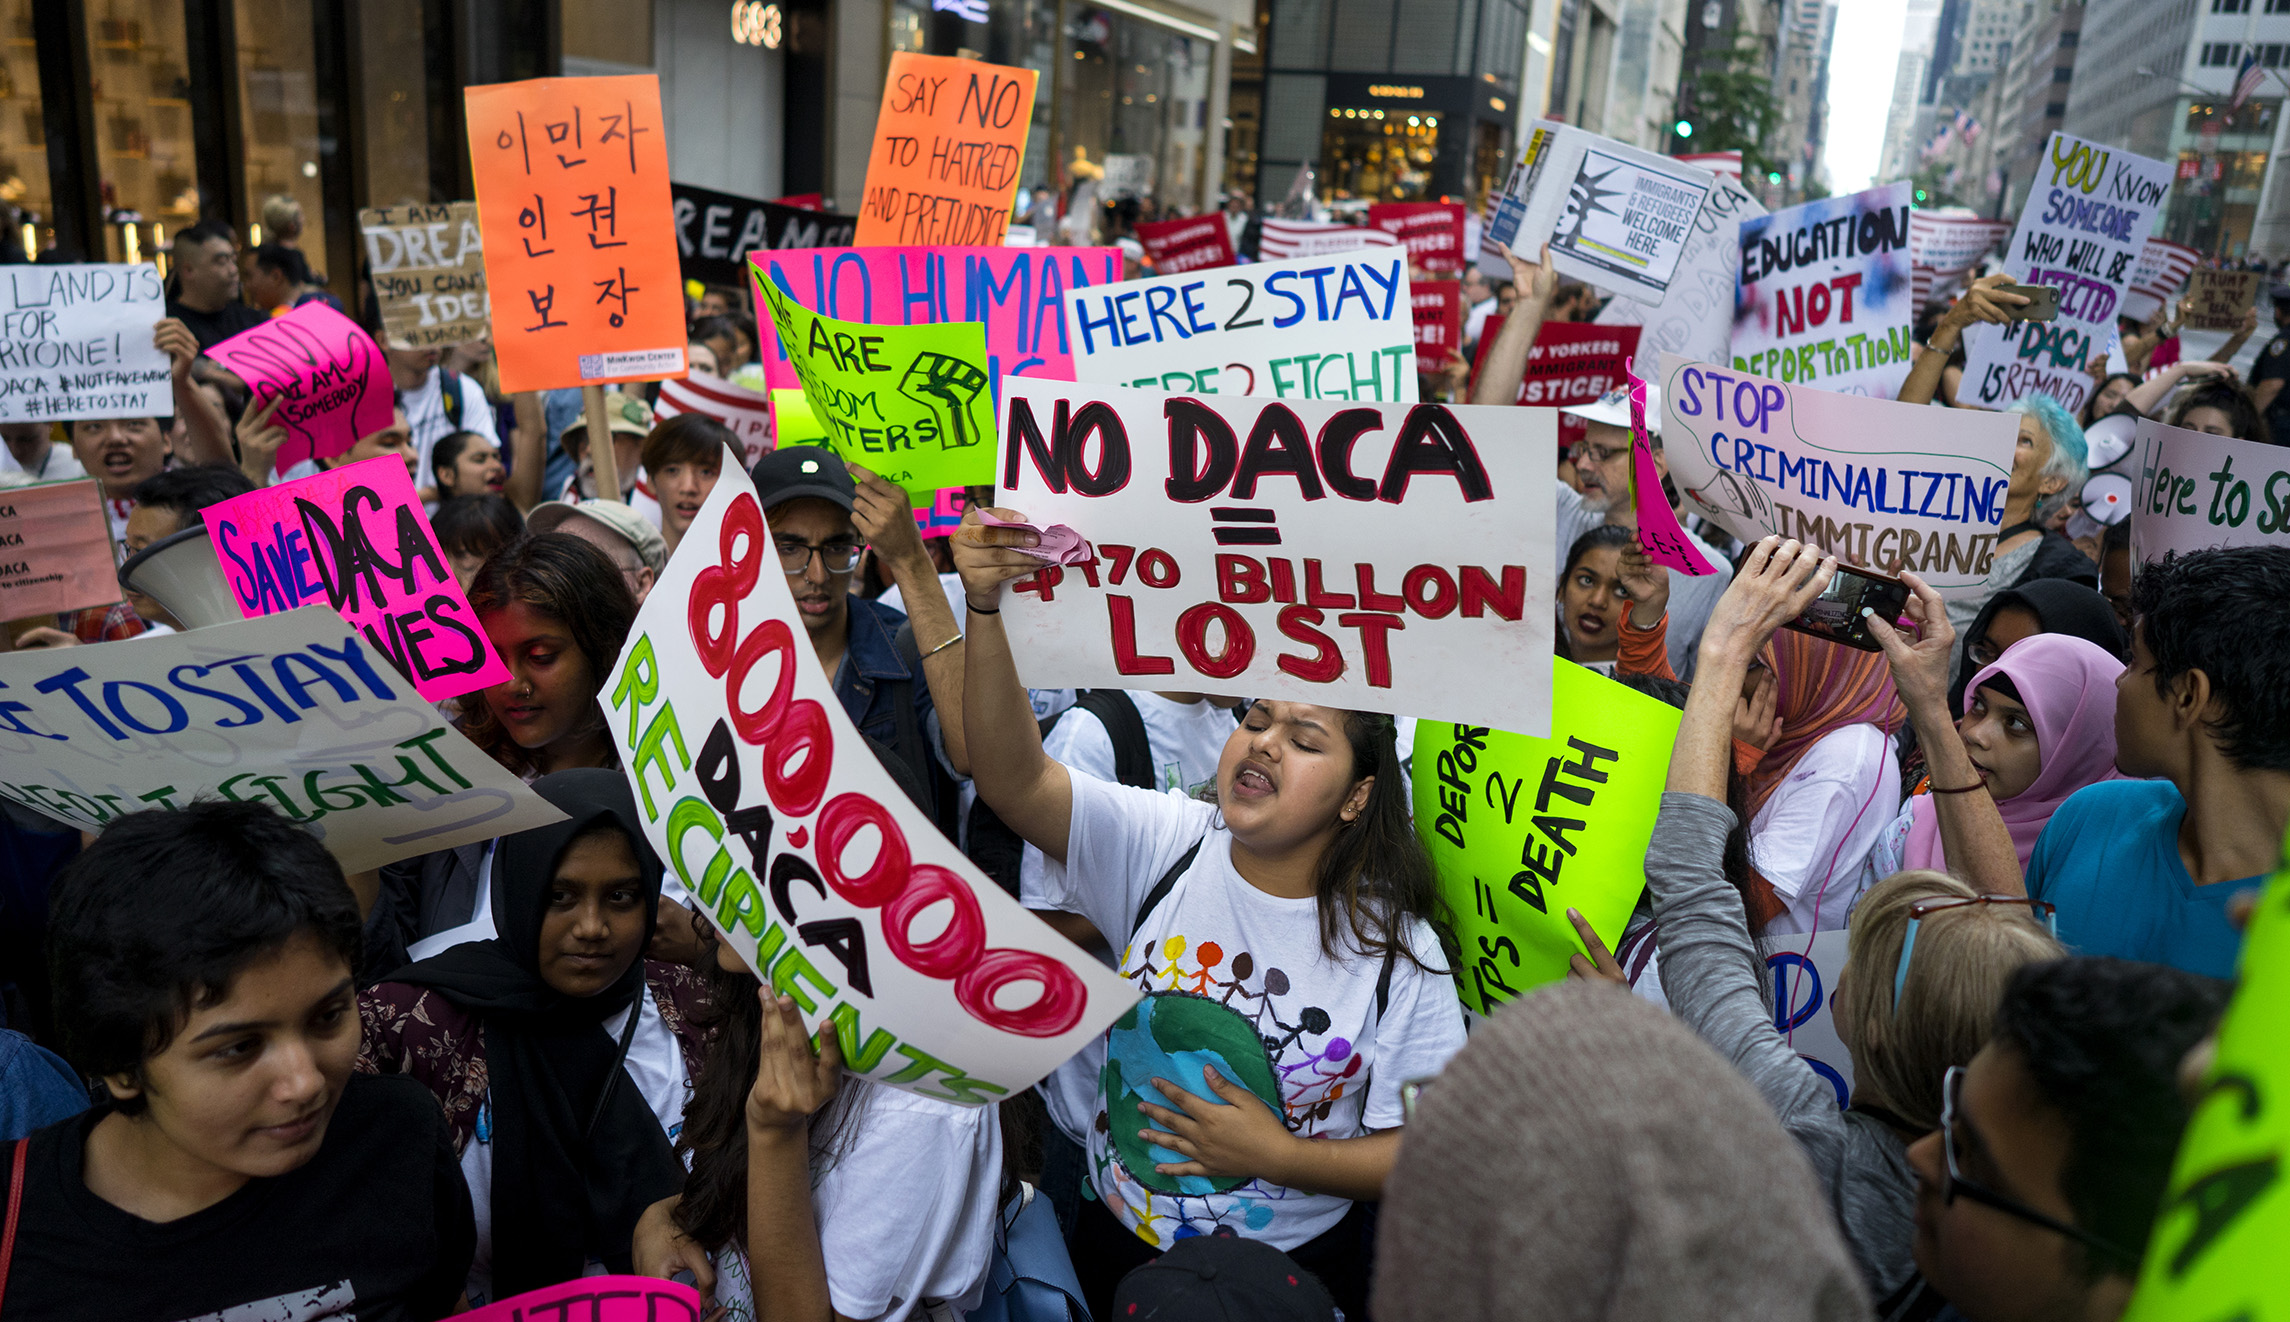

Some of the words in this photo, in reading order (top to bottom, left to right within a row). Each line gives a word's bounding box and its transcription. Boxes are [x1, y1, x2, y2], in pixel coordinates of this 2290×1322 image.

[891, 74, 947, 117] SAY
[958, 73, 1020, 129] NO
[497, 100, 649, 175] 이민자
[886, 137, 919, 167] TO
[928, 136, 1019, 192] HATRED
[1634, 176, 1699, 210] IMMIGRANTS
[2051, 136, 2110, 194] YOU
[2107, 160, 2168, 208] KNOW
[375, 209, 394, 225] I
[408, 206, 450, 224] AM
[518, 186, 628, 258] 인권
[864, 187, 901, 223] AND
[1621, 207, 1686, 244] WELCOME
[1628, 191, 1638, 207] &
[1637, 194, 1692, 226] REFUGEES
[2042, 188, 2139, 243] SOMEONE
[1624, 229, 1661, 258] HERE.
[1741, 206, 1910, 285] EDUCATION
[2024, 231, 2063, 263] WHO
[2065, 238, 2107, 276] WILL
[2106, 250, 2135, 285] BE
[12, 270, 115, 310] LAND
[121, 269, 161, 303] IS
[377, 277, 422, 300] YOU
[525, 267, 640, 333] 보장
[770, 252, 873, 361] NO
[1076, 281, 1217, 355] HERE
[1224, 279, 1264, 331] 2
[1264, 260, 1401, 328] STAY
[1776, 272, 1862, 338] NOT
[4, 310, 59, 340] FOR
[808, 317, 892, 375] ARE
[1548, 340, 1621, 359] YORKERS
[2017, 321, 2092, 372] DACA
[287, 372, 365, 425] SOMEBODY
[289, 377, 307, 401] I
[312, 361, 346, 394] AM
[1679, 368, 1786, 434] STOP
[1978, 363, 2006, 404] IS
[1003, 396, 1132, 498] NO
[1164, 396, 1495, 503] DACA
[1711, 431, 2009, 526] CRIMINALIZING
[2138, 437, 2198, 518] Here
[2208, 454, 2251, 529] to
[219, 520, 326, 616] SAVE
[294, 485, 449, 614] DACA
[1210, 507, 1282, 546] =
[15, 573, 64, 587] citizenship
[1215, 553, 1527, 621] BILLON
[1106, 593, 1406, 689] LOST
[34, 666, 190, 741] TO
[168, 636, 397, 729] STAY
[687, 491, 1088, 1038] 800,000
[1486, 771, 1523, 825] 2
[1508, 735, 1620, 915] DEATH
[611, 631, 1011, 1105] RECIPIENTS
[696, 716, 874, 999] DACA
